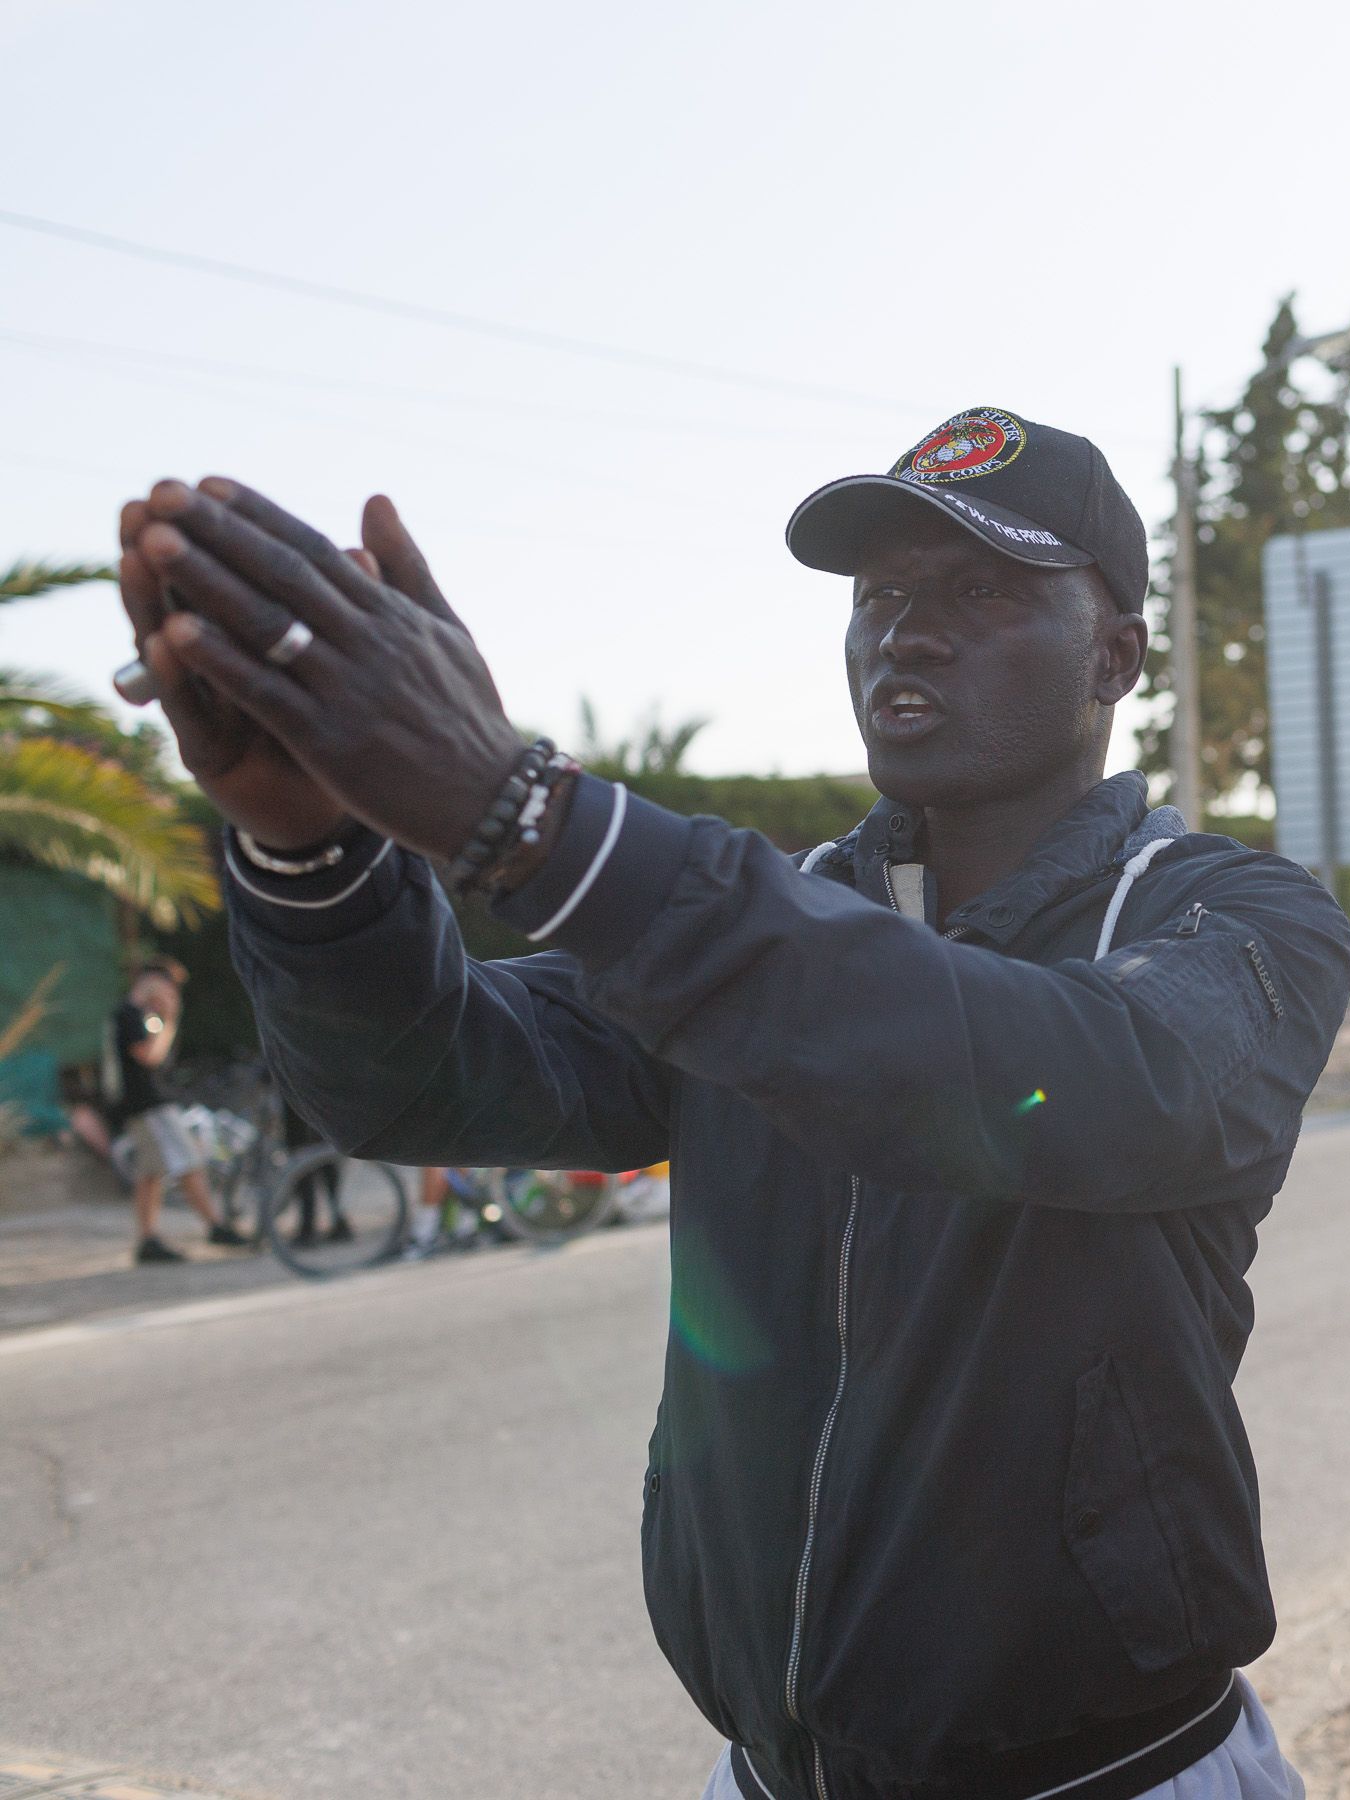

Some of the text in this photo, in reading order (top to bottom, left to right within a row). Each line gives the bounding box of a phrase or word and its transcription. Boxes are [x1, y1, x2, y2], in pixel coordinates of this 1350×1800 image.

[980, 410, 1021, 442] STATES
[949, 458, 1003, 479] CORPS
[989, 519, 1023, 541] THE
[1245, 940, 1284, 1019] PULL&BEAR
